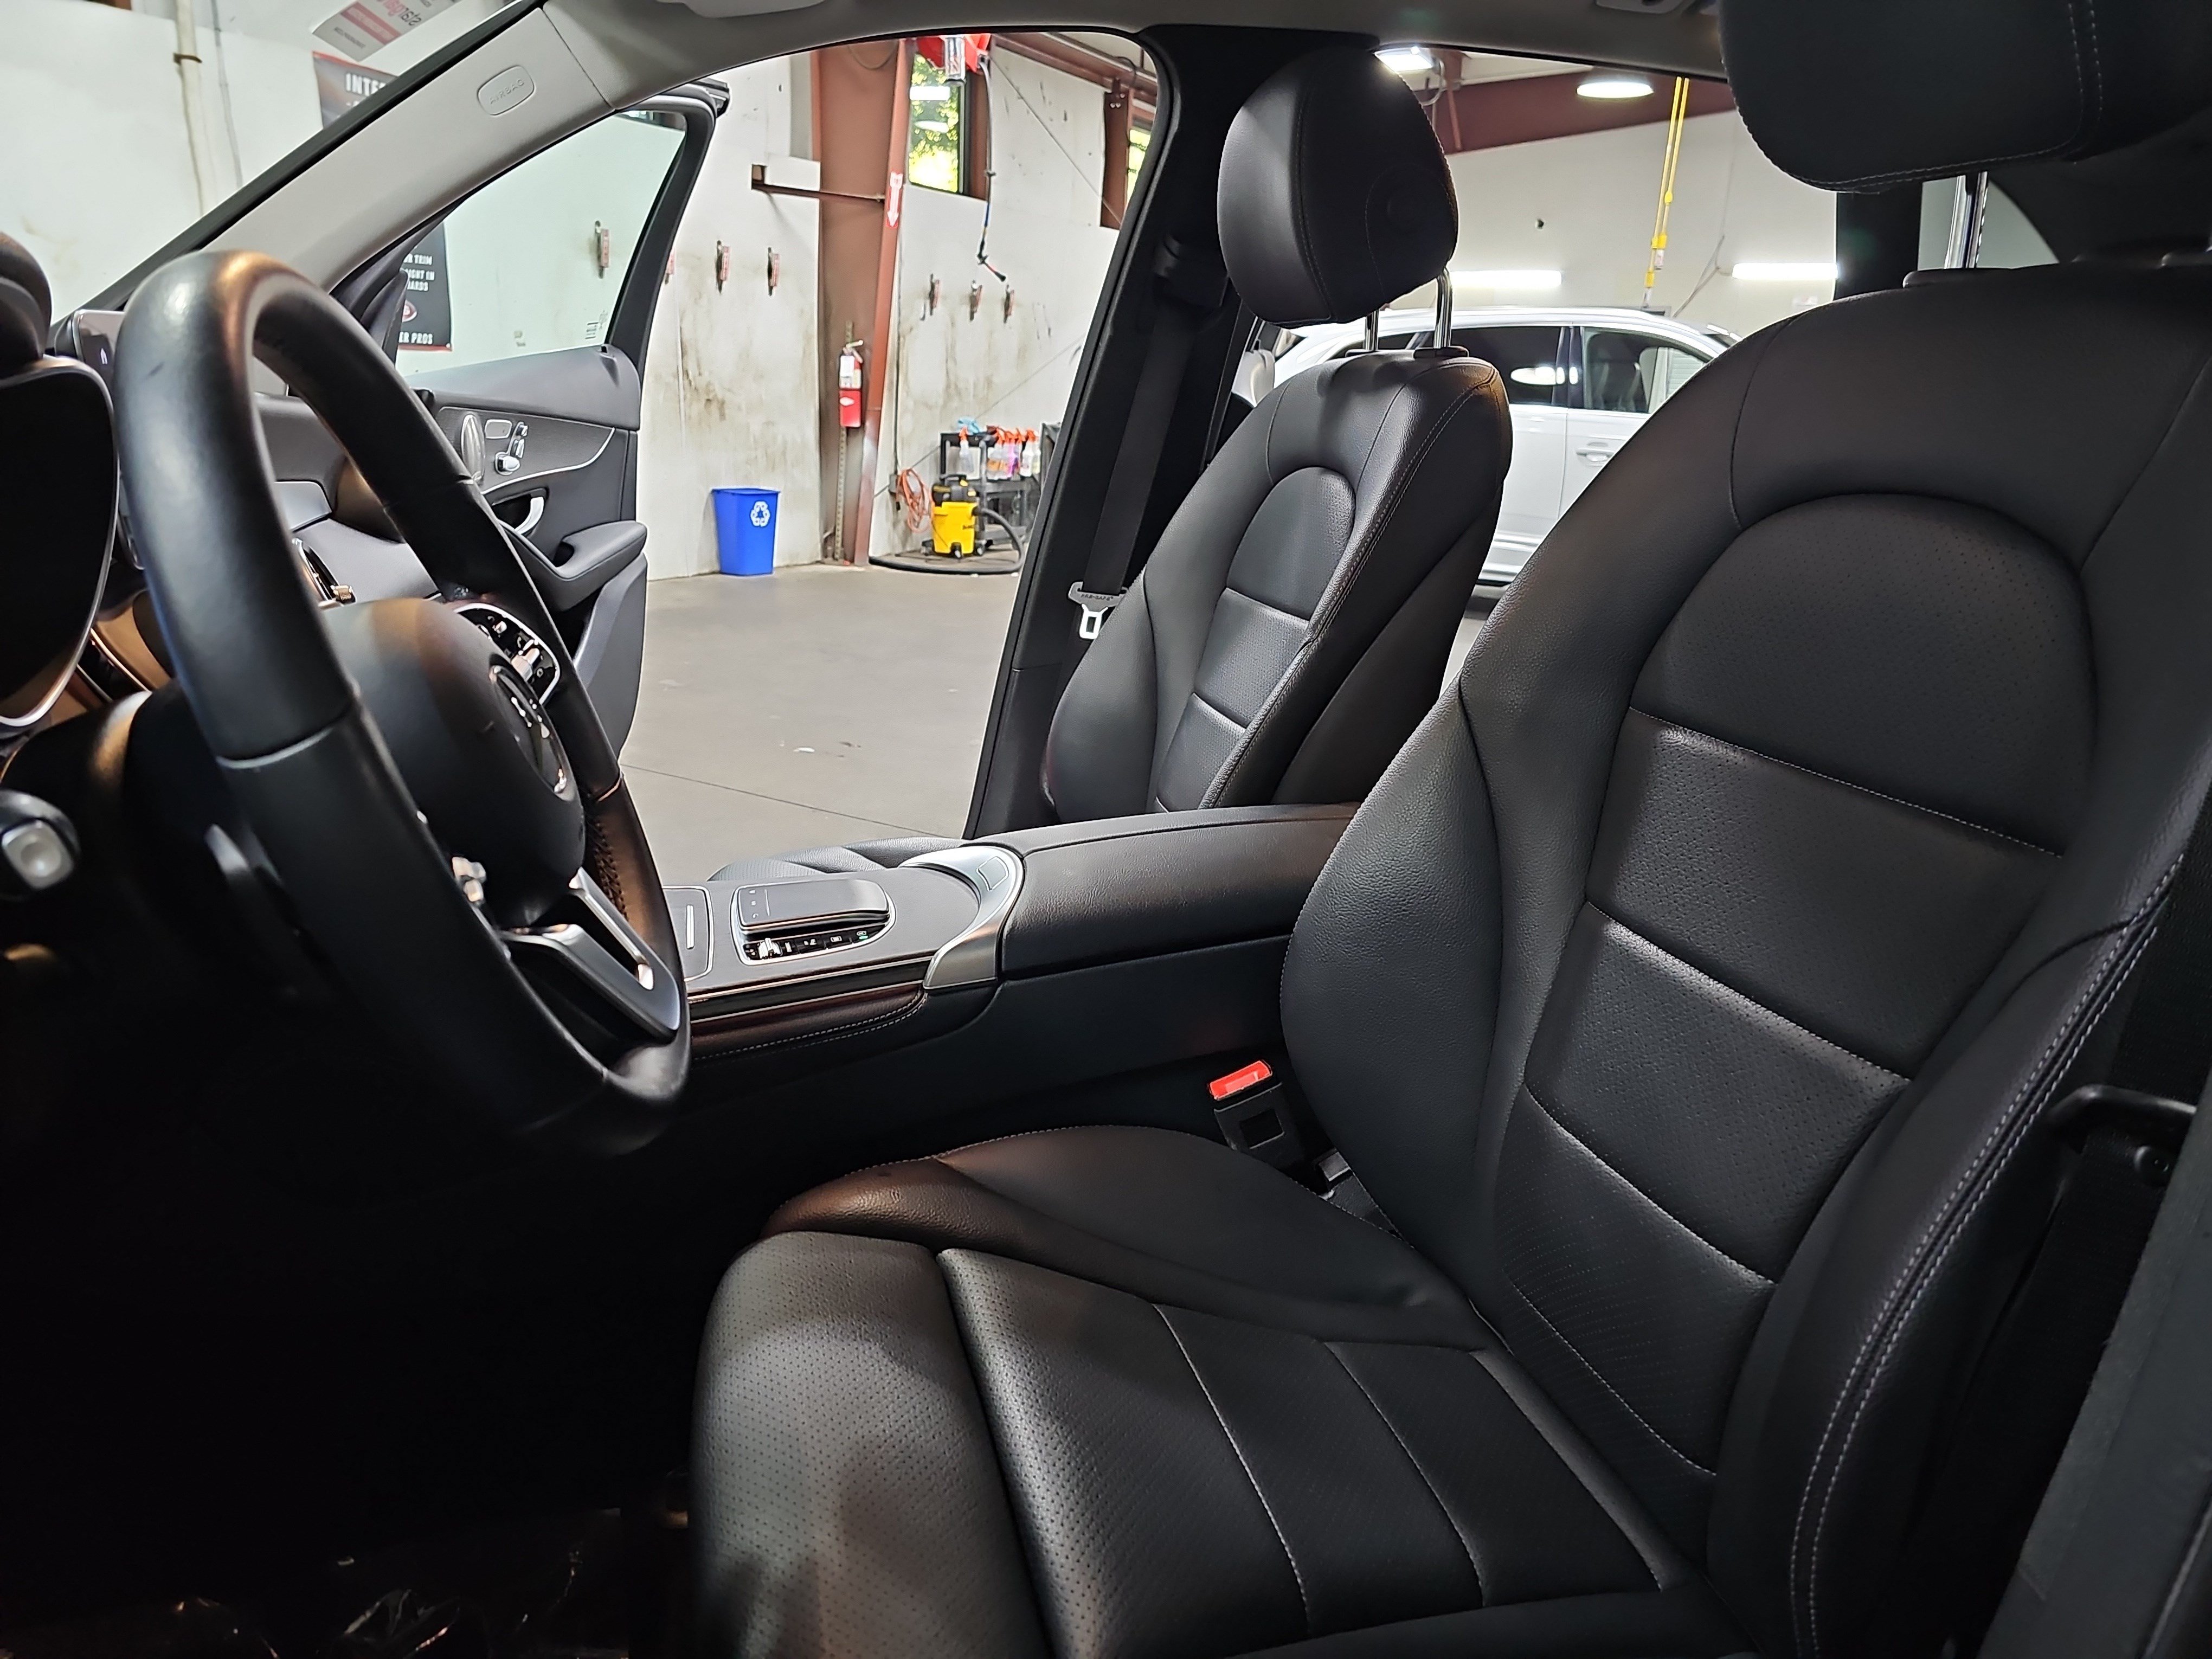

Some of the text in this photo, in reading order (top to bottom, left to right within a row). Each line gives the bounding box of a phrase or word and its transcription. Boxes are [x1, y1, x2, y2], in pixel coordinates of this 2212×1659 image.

[490, 78, 524, 105] AIRBAG
[414, 254, 433, 266] TRIM
[426, 271, 435, 281] IN
[410, 332, 433, 345] PROS
